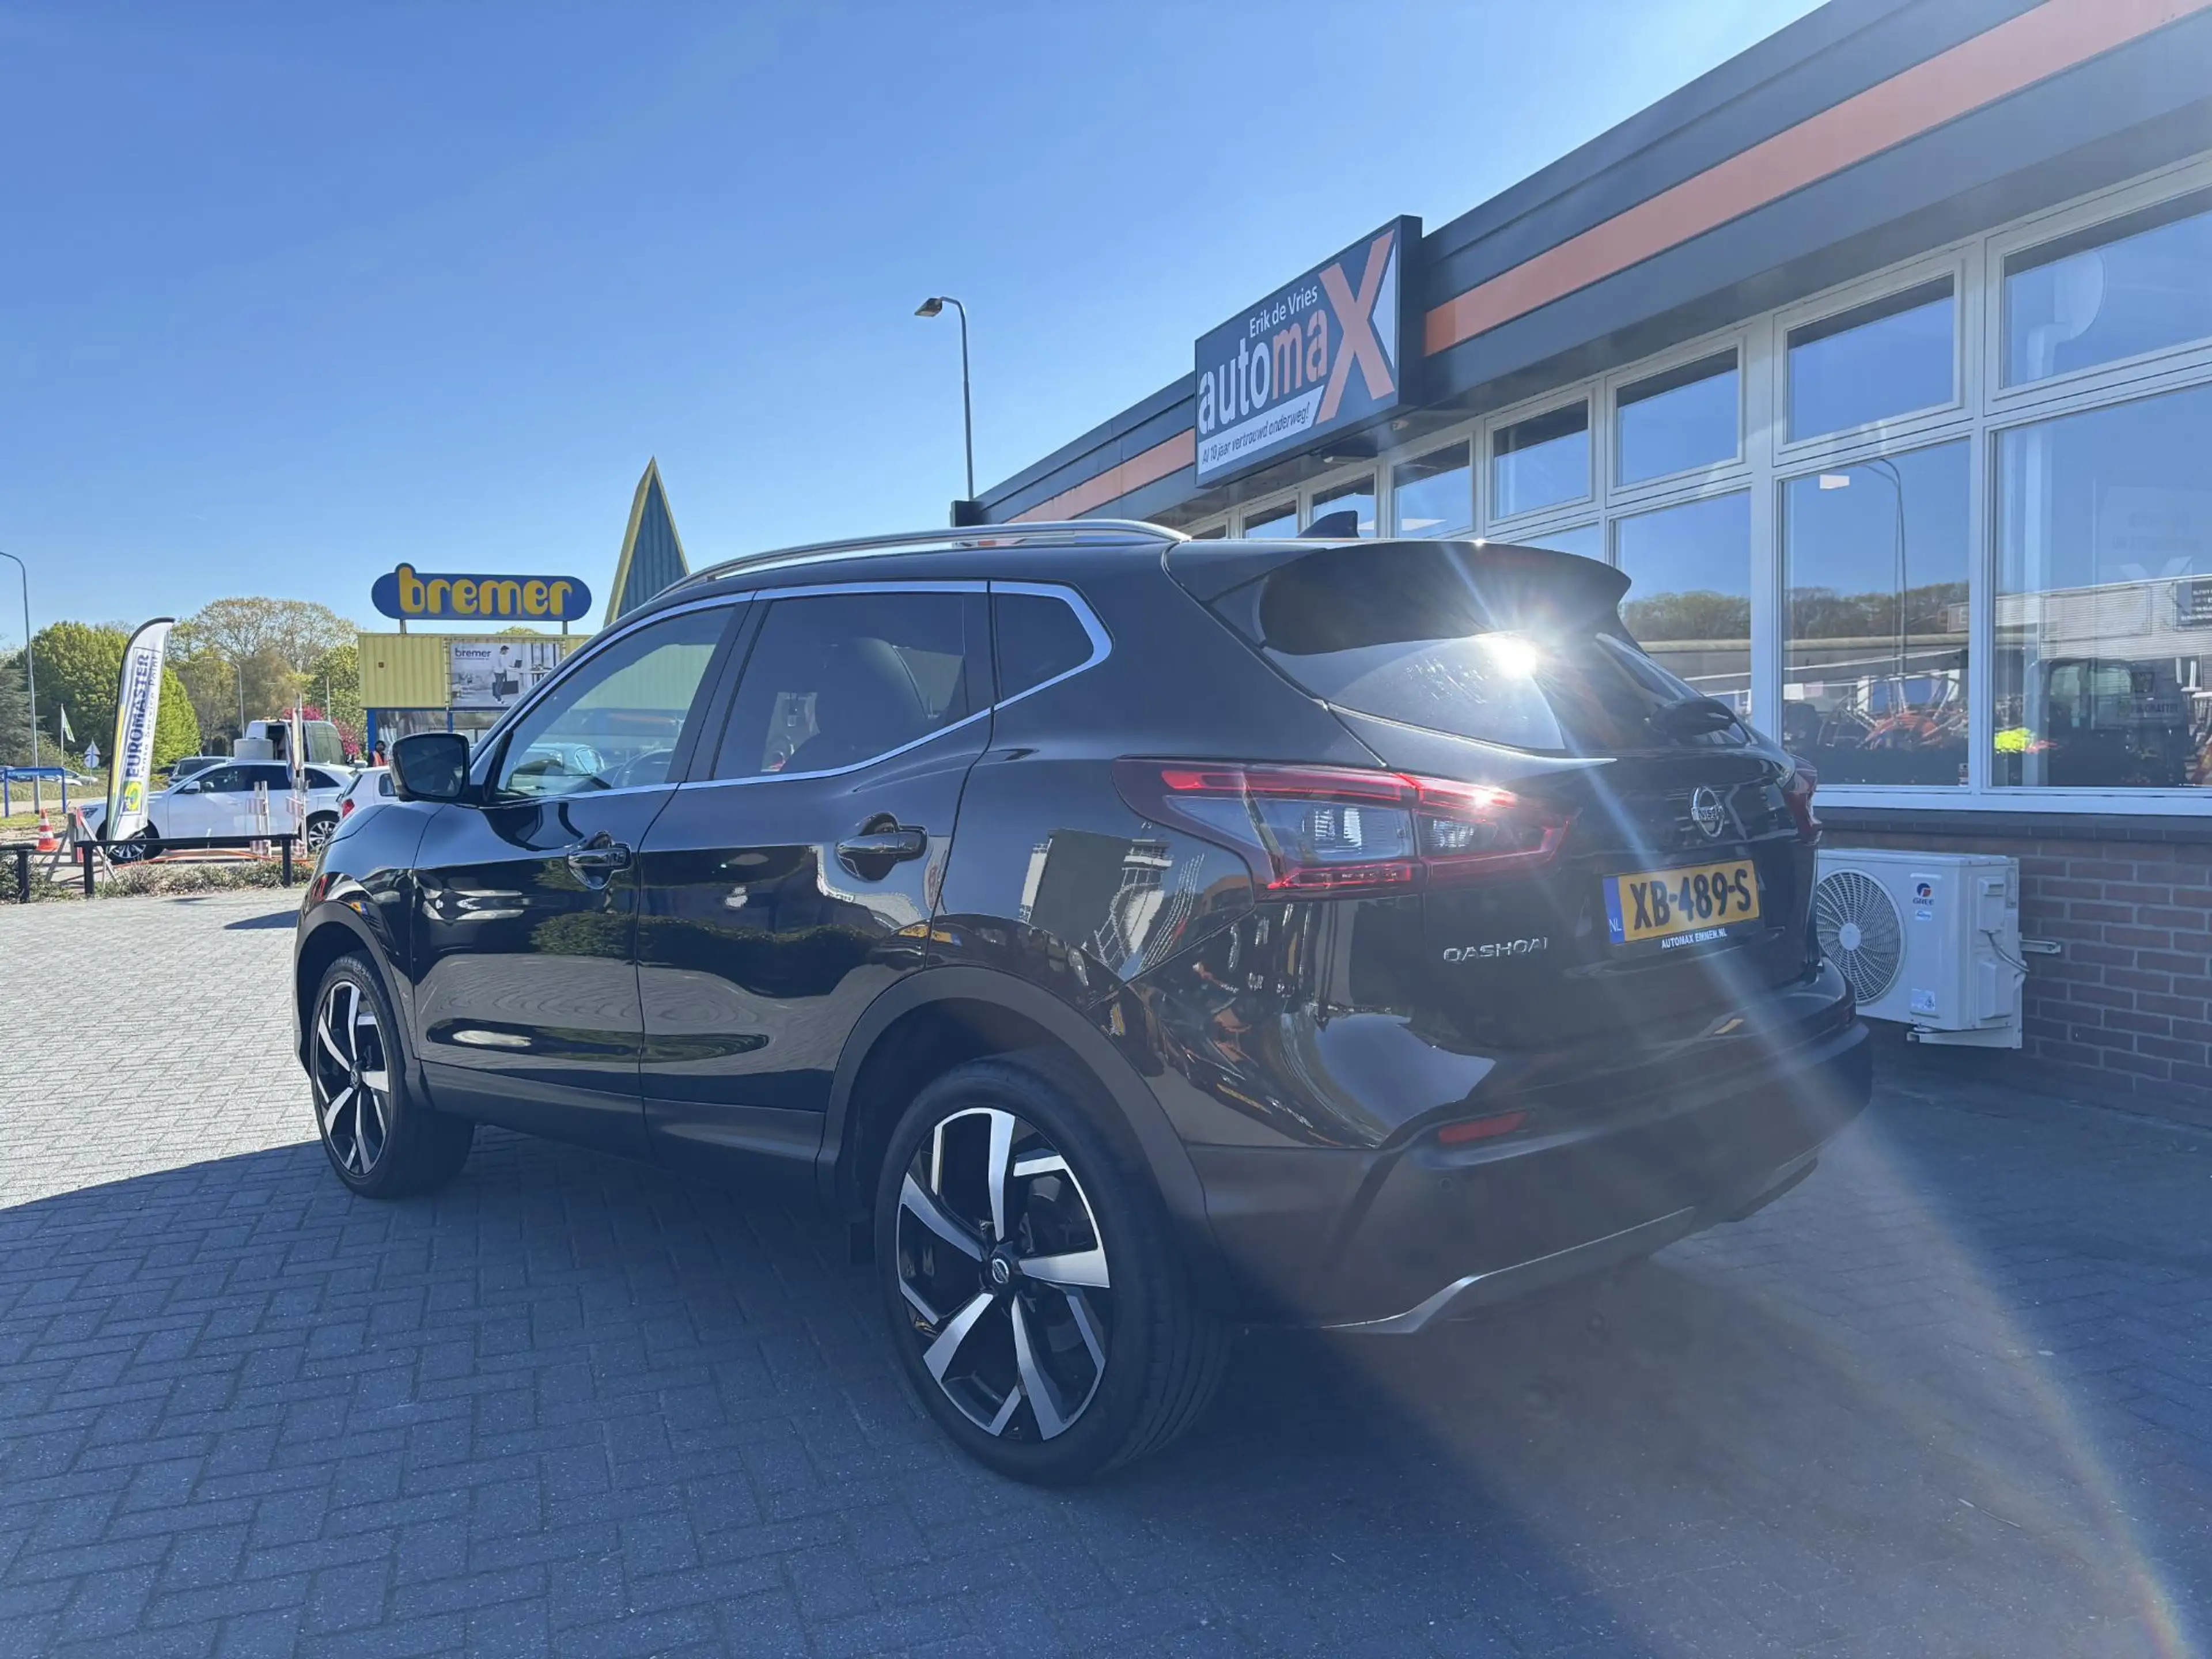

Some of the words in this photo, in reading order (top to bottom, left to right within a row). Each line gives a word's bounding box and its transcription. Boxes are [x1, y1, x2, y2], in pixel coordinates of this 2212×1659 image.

[1249, 316, 1270, 338] Erik
[1272, 302, 1286, 325] de
[1287, 285, 1317, 315] Vries
[1217, 441, 1231, 461] jaar
[1232, 421, 1268, 453] vertrouwd
[1268, 402, 1310, 436] onderweg!
[399, 566, 573, 616] bremer
[148, 656, 158, 686] Point
[454, 648, 491, 657] bremer
[125, 654, 149, 778] EUROMASTER
[1630, 868, 1751, 931] XB-489-S
[1609, 918, 1622, 933] NL
[1661, 933, 1694, 950] AUTOMAX
